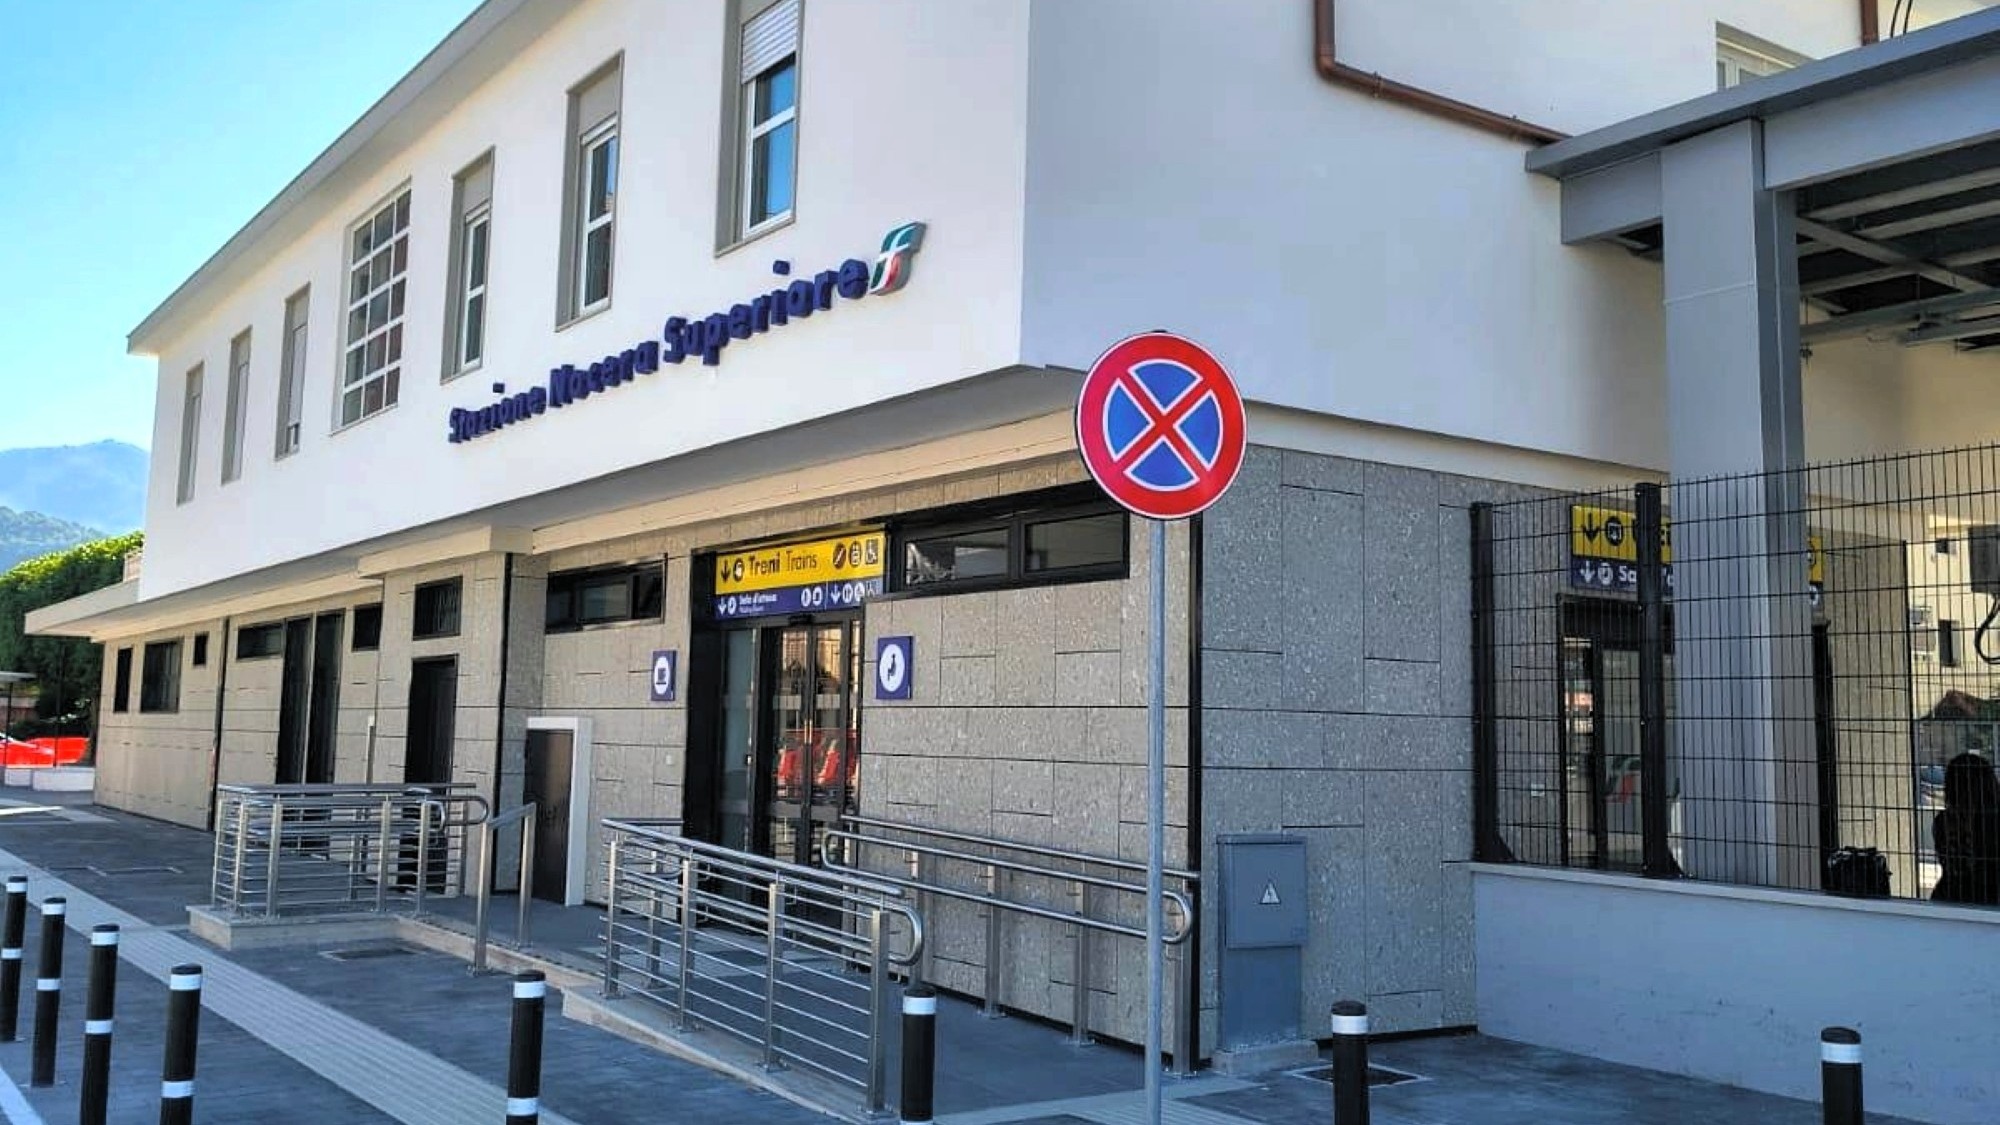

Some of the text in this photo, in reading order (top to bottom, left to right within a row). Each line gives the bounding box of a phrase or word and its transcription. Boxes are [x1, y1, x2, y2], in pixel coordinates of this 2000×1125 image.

[448, 259, 870, 443] Stazione Nocera Superiore
[749, 549, 818, 577] Treni Trains
